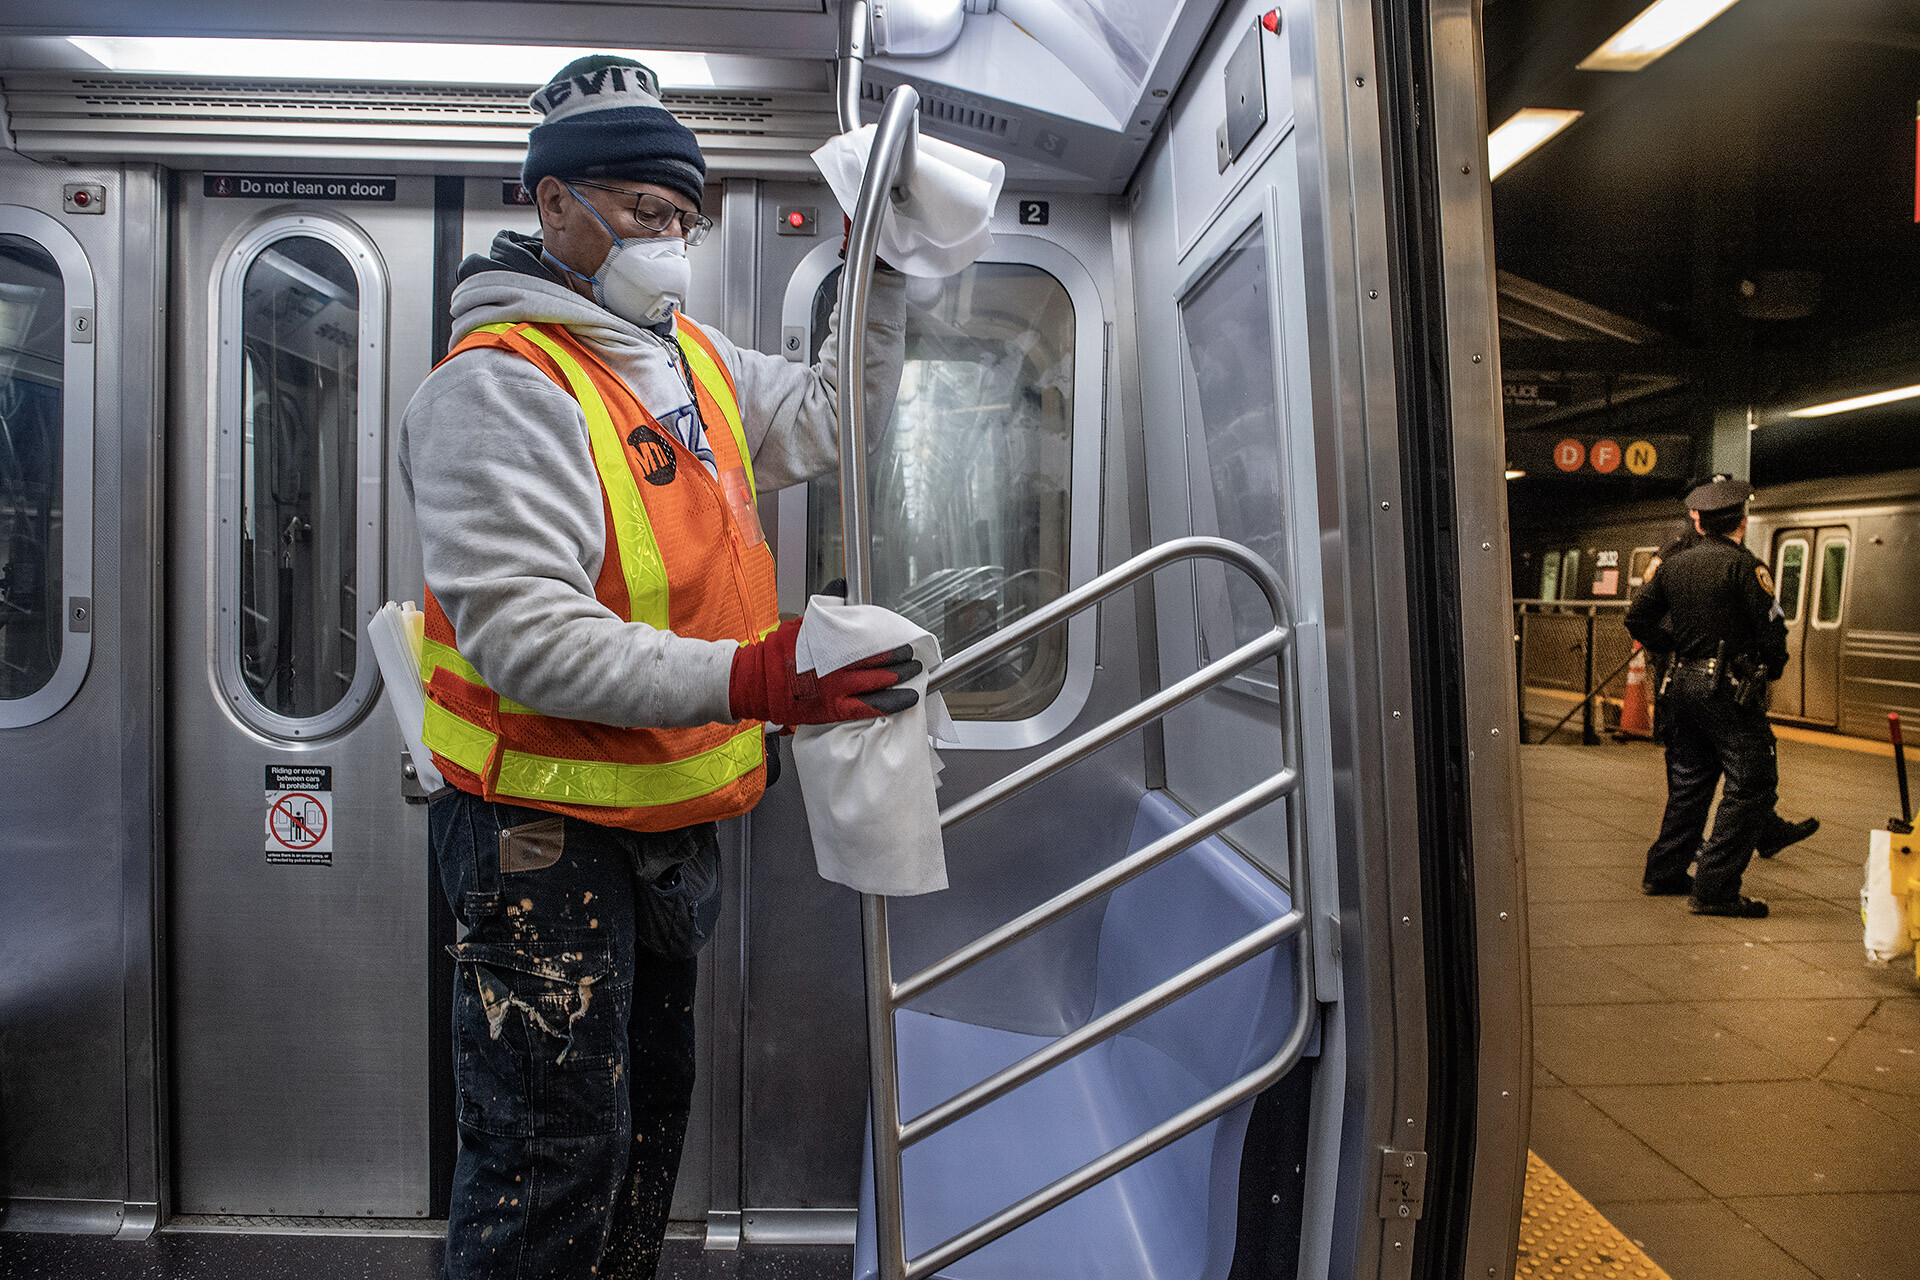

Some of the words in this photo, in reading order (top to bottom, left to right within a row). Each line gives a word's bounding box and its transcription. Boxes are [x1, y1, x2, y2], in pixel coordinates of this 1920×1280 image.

[240, 179, 261, 194] Do
[265, 180, 290, 194] not
[293, 180, 323, 195] lean
[327, 183, 347, 195] on
[350, 182, 386, 196] door
[1027, 203, 1042, 223] 2
[1562, 445, 1578, 465] D
[1599, 447, 1613, 466] F
[1634, 448, 1648, 467] N
[271, 766, 292, 775] Riding
[301, 767, 325, 776] moving
[286, 782, 319, 790] prohibited
